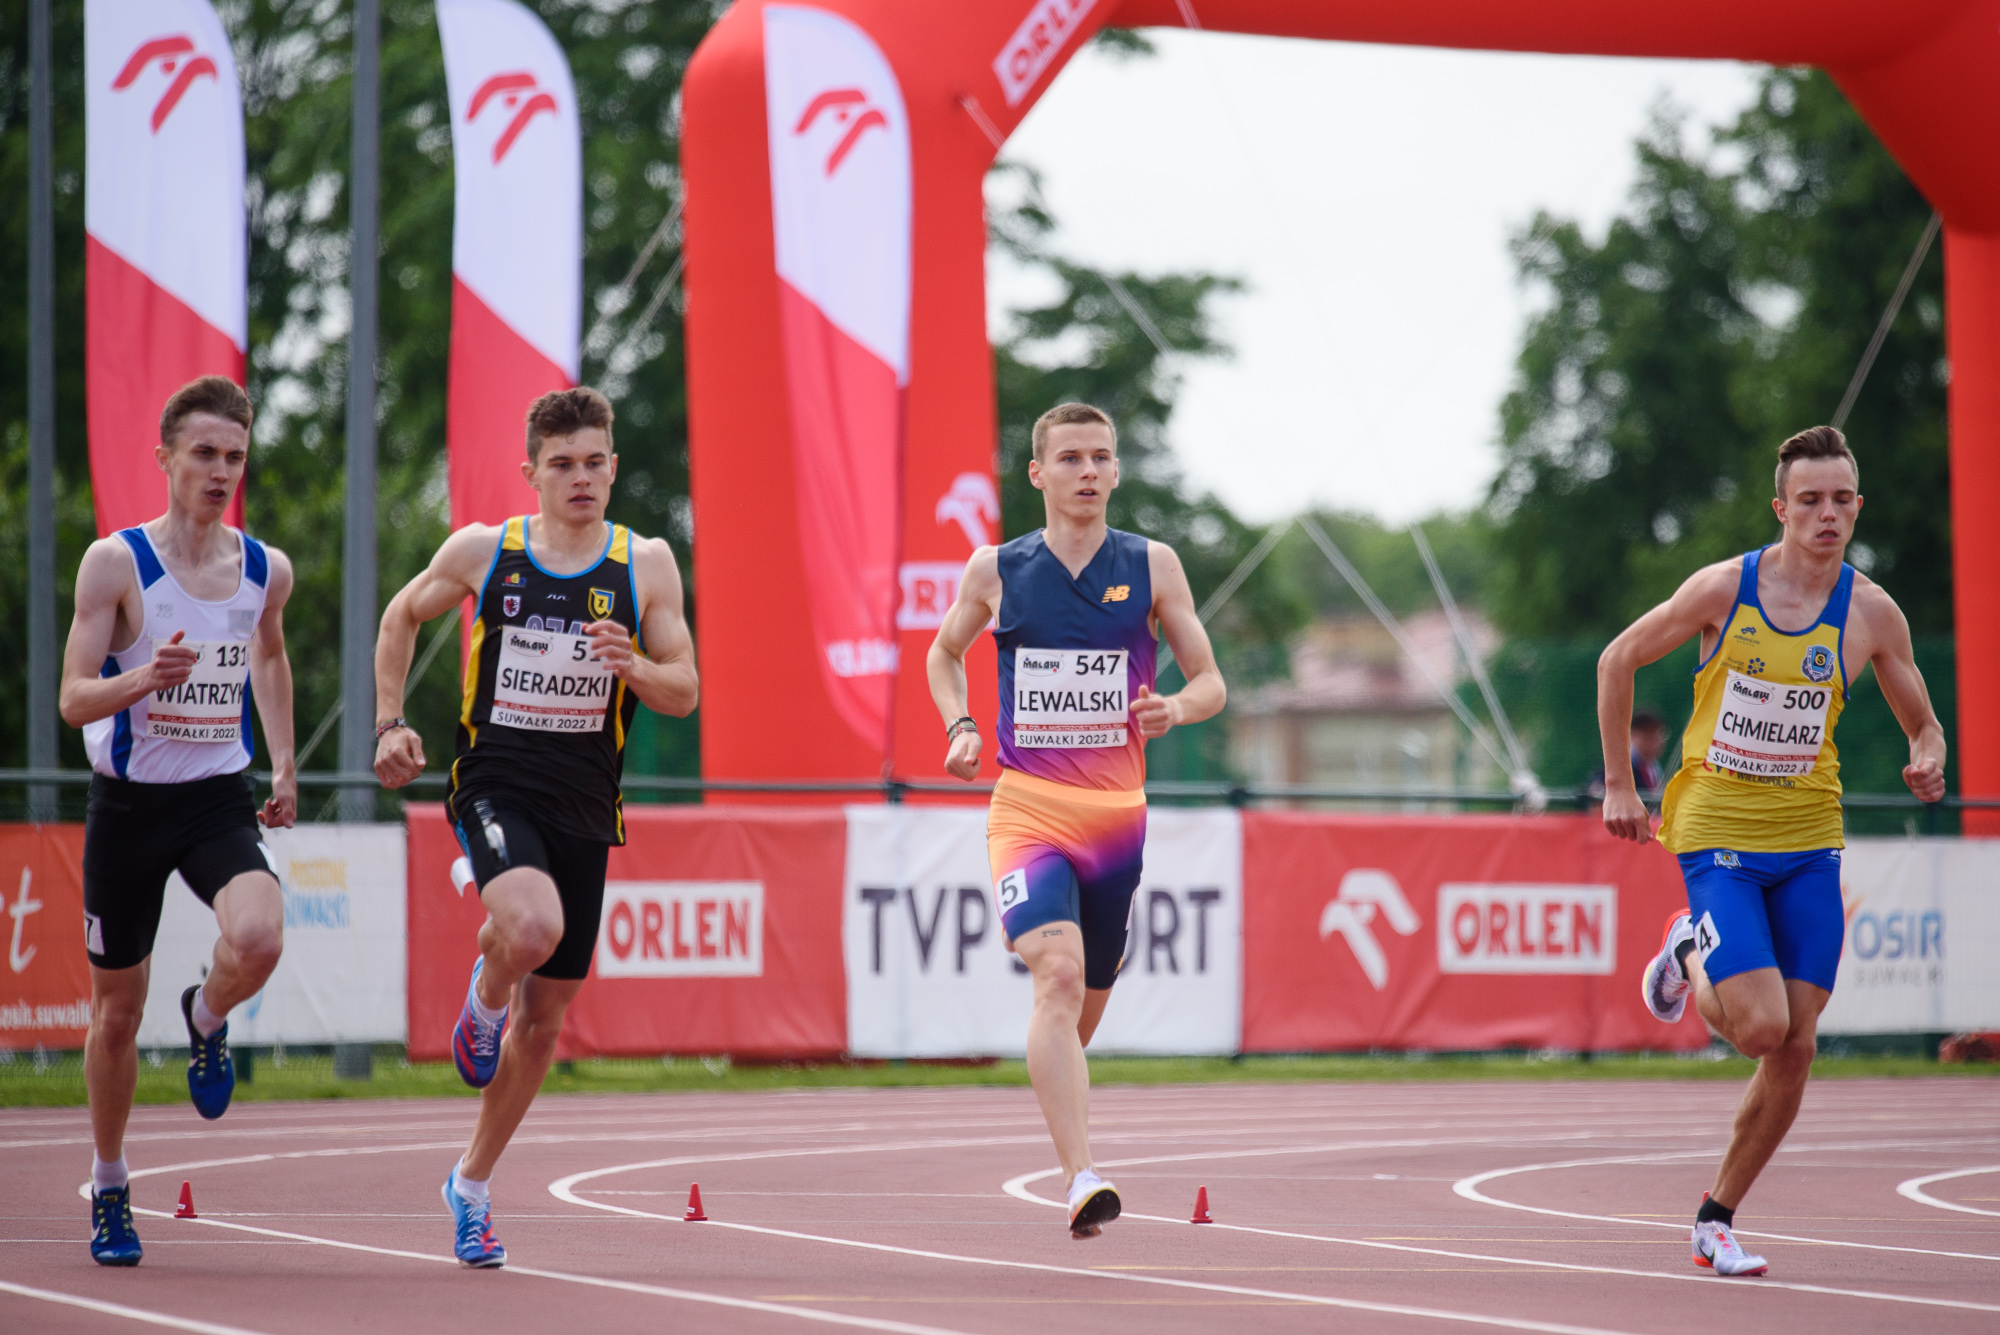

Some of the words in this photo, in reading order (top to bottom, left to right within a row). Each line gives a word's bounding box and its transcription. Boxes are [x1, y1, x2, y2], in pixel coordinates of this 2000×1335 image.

[1075, 655, 1121, 675] 547
[501, 667, 608, 697] SIERADZKI
[1018, 690, 1123, 712] LEWALSKI
[1783, 690, 1826, 710] 500
[153, 724, 209, 738] SUWAŁKI
[213, 728, 235, 739] 2022
[497, 711, 553, 728] SUWAŁKI
[556, 719, 586, 729] 2022
[1722, 711, 1821, 745] CHMIELARZ
[1020, 734, 1074, 745] SUWAŁKI
[1078, 734, 1107, 744] 2022
[1713, 751, 1767, 773] SUWAŁKI
[1770, 764, 1797, 773] 2022
[1000, 875, 1018, 907] 5
[607, 899, 749, 962] ORLEN
[861, 887, 987, 974] TVP
[1041, 928, 1063, 937] run
[1453, 902, 1602, 956] ORLEN
[1700, 922, 1713, 952] 4
[1852, 910, 1944, 961] OSIR
